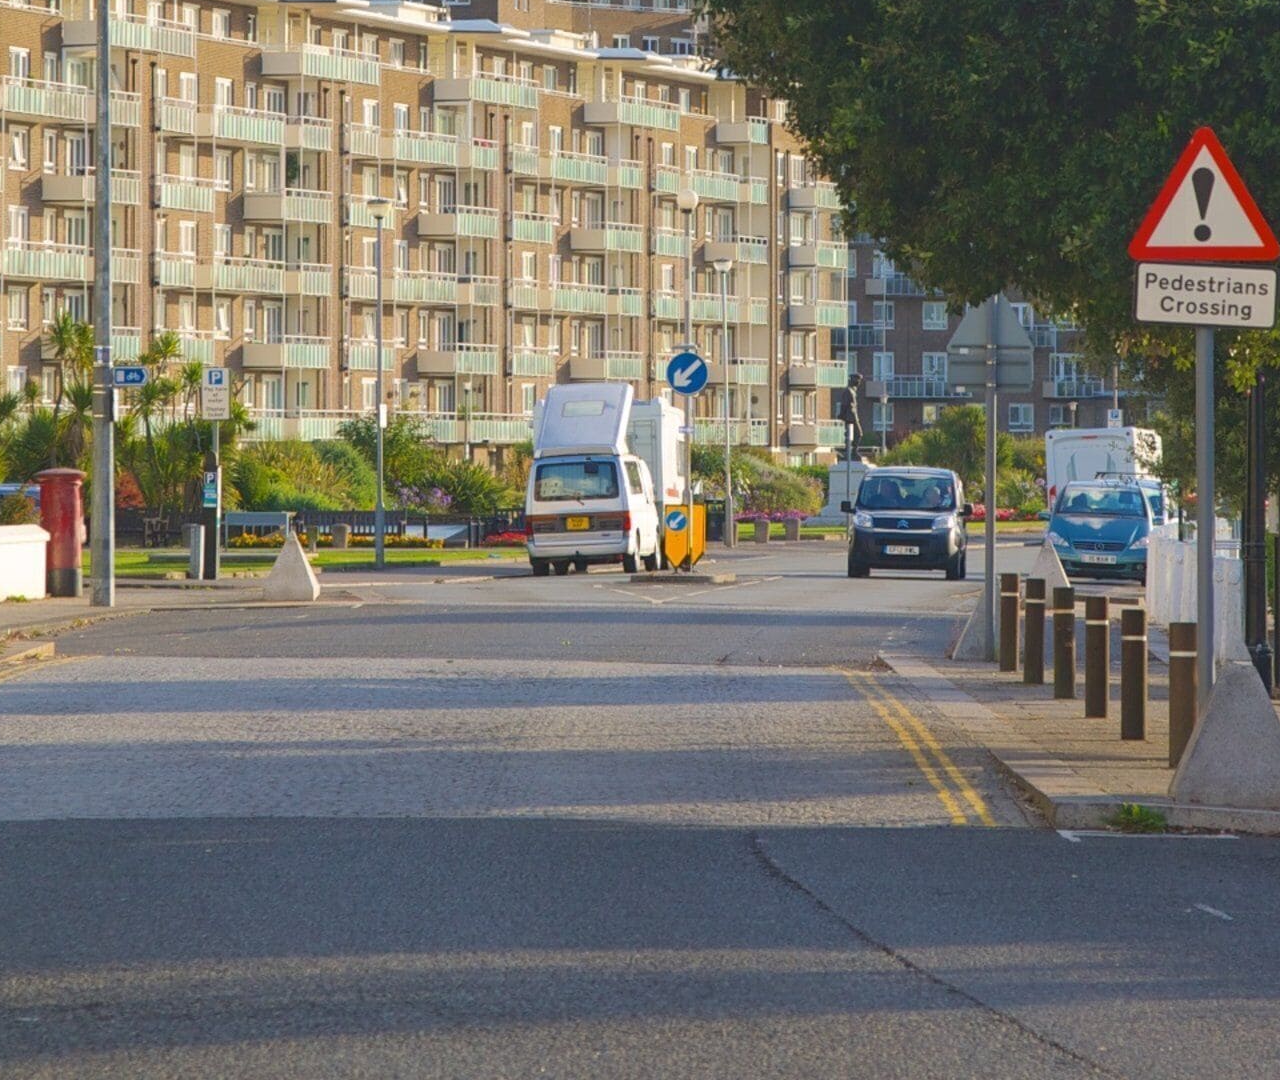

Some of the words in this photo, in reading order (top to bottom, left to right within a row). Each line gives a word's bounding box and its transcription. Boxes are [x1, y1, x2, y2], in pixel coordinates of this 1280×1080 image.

[1145, 272, 1269, 296] Pedestrians
[1160, 296, 1252, 321] Crossing
[211, 371, 221, 385] P
